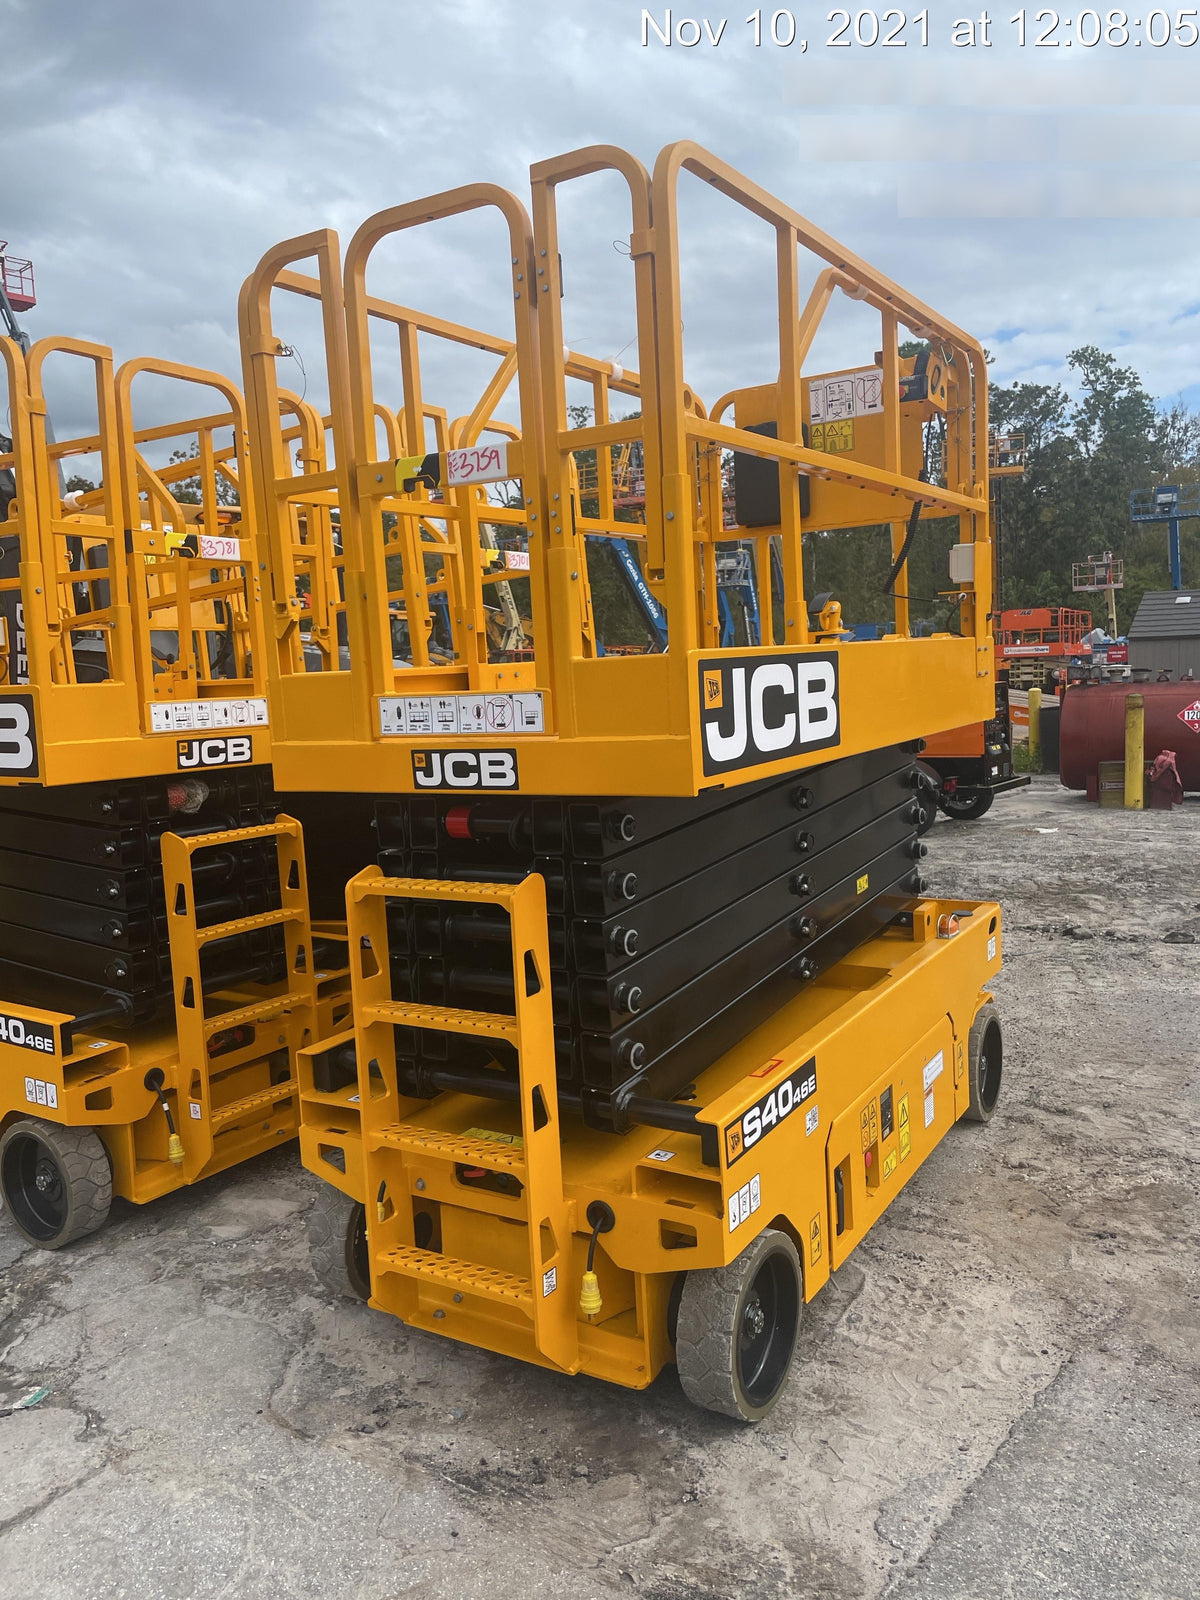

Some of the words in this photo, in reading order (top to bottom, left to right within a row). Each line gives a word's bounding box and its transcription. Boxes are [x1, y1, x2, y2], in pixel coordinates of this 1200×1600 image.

[459, 446, 501, 478] 3759
[206, 540, 236, 556] 3781
[705, 660, 838, 762] JCB
[179, 738, 251, 768] JCB
[415, 752, 516, 787] JCB
